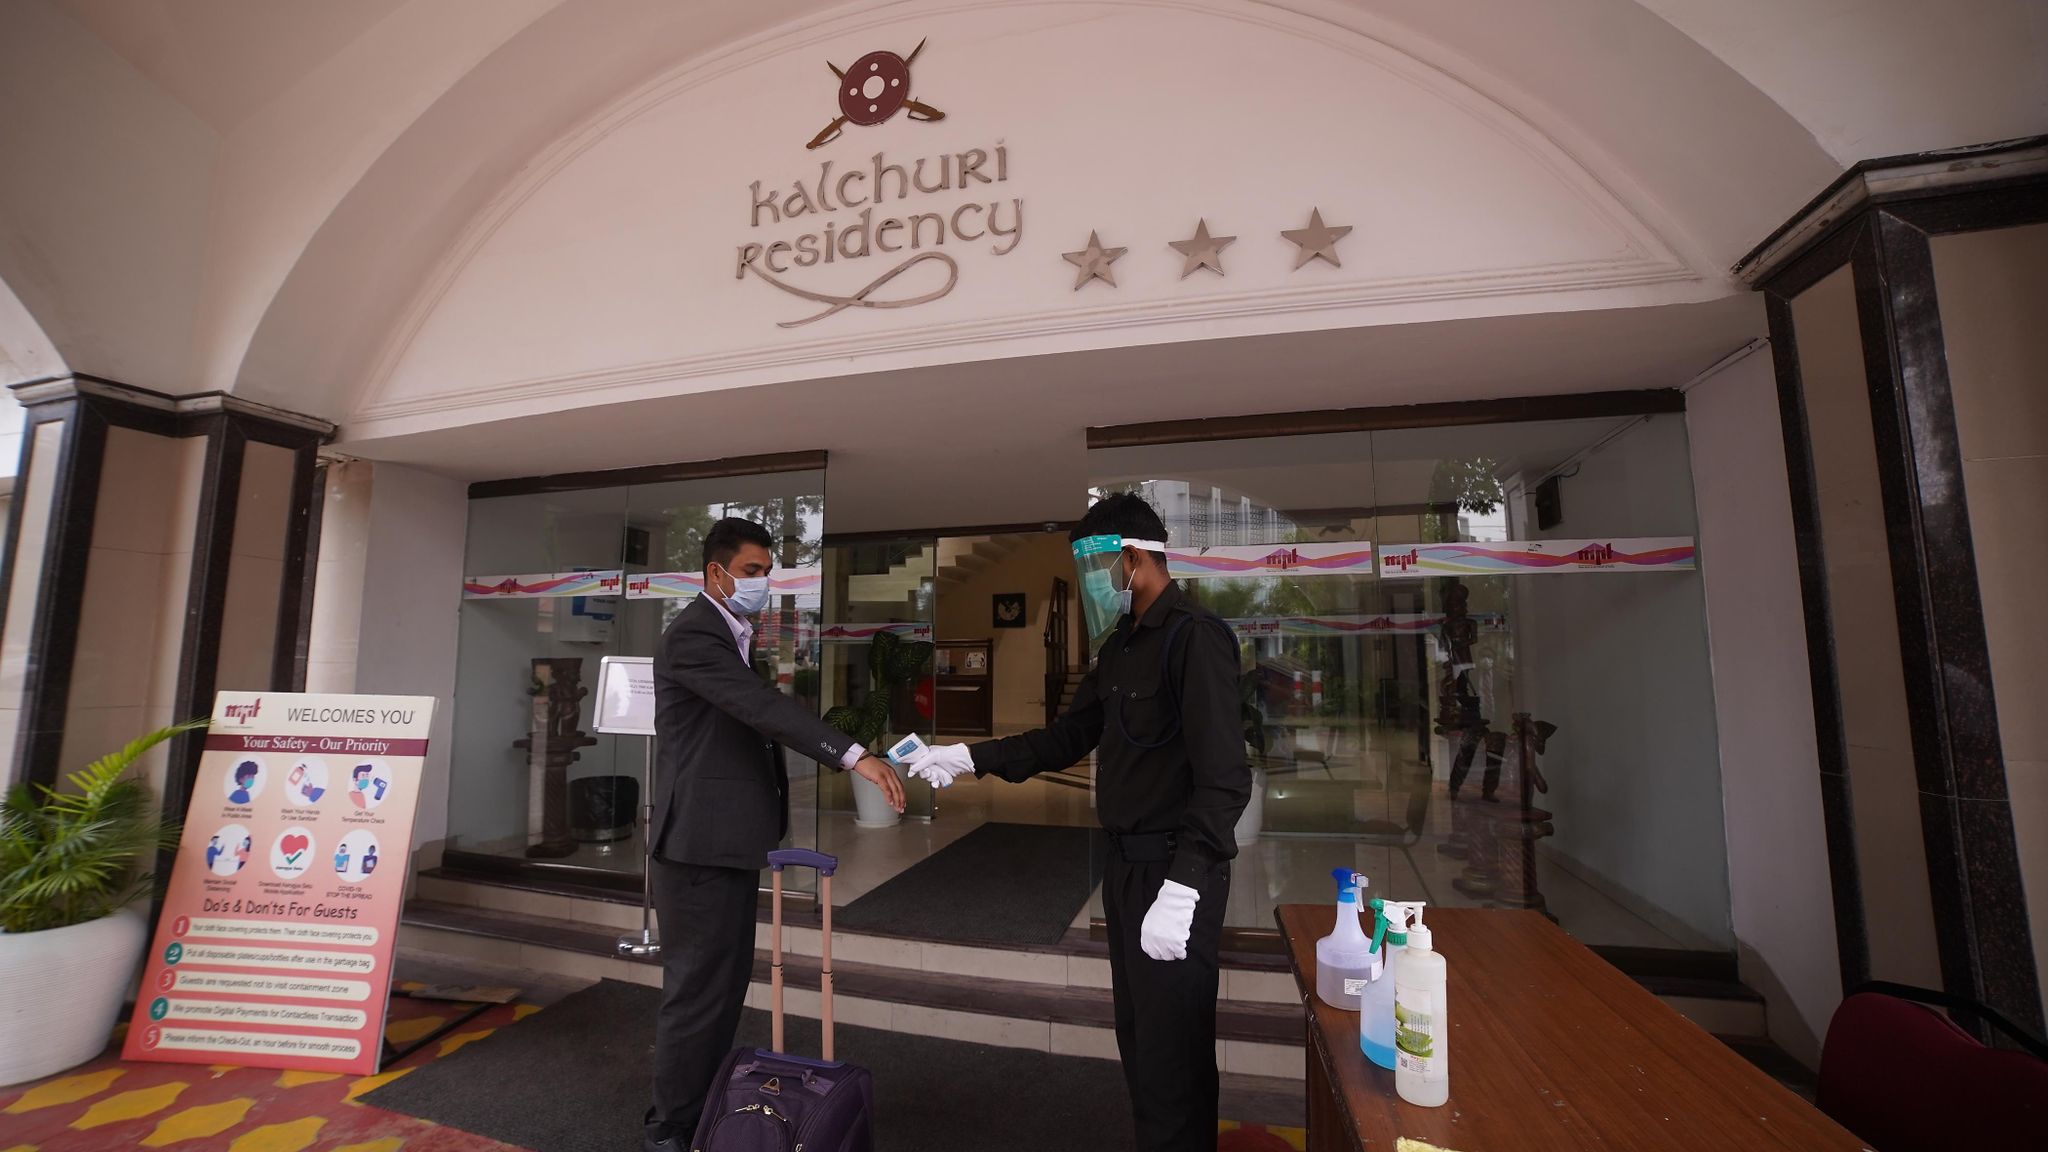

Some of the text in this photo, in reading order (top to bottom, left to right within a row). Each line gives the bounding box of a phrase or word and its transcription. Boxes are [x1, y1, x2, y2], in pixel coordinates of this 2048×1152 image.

[288, 708, 414, 724] WELCOMES YOU
[243, 736, 270, 748] Your
[272, 736, 308, 752] Safety
[320, 737, 343, 750] Our
[345, 738, 390, 754] Priority
[203, 898, 358, 919] Do's & Don'ts For Guests
[179, 975, 203, 984] Guests
[287, 982, 329, 992] containment
